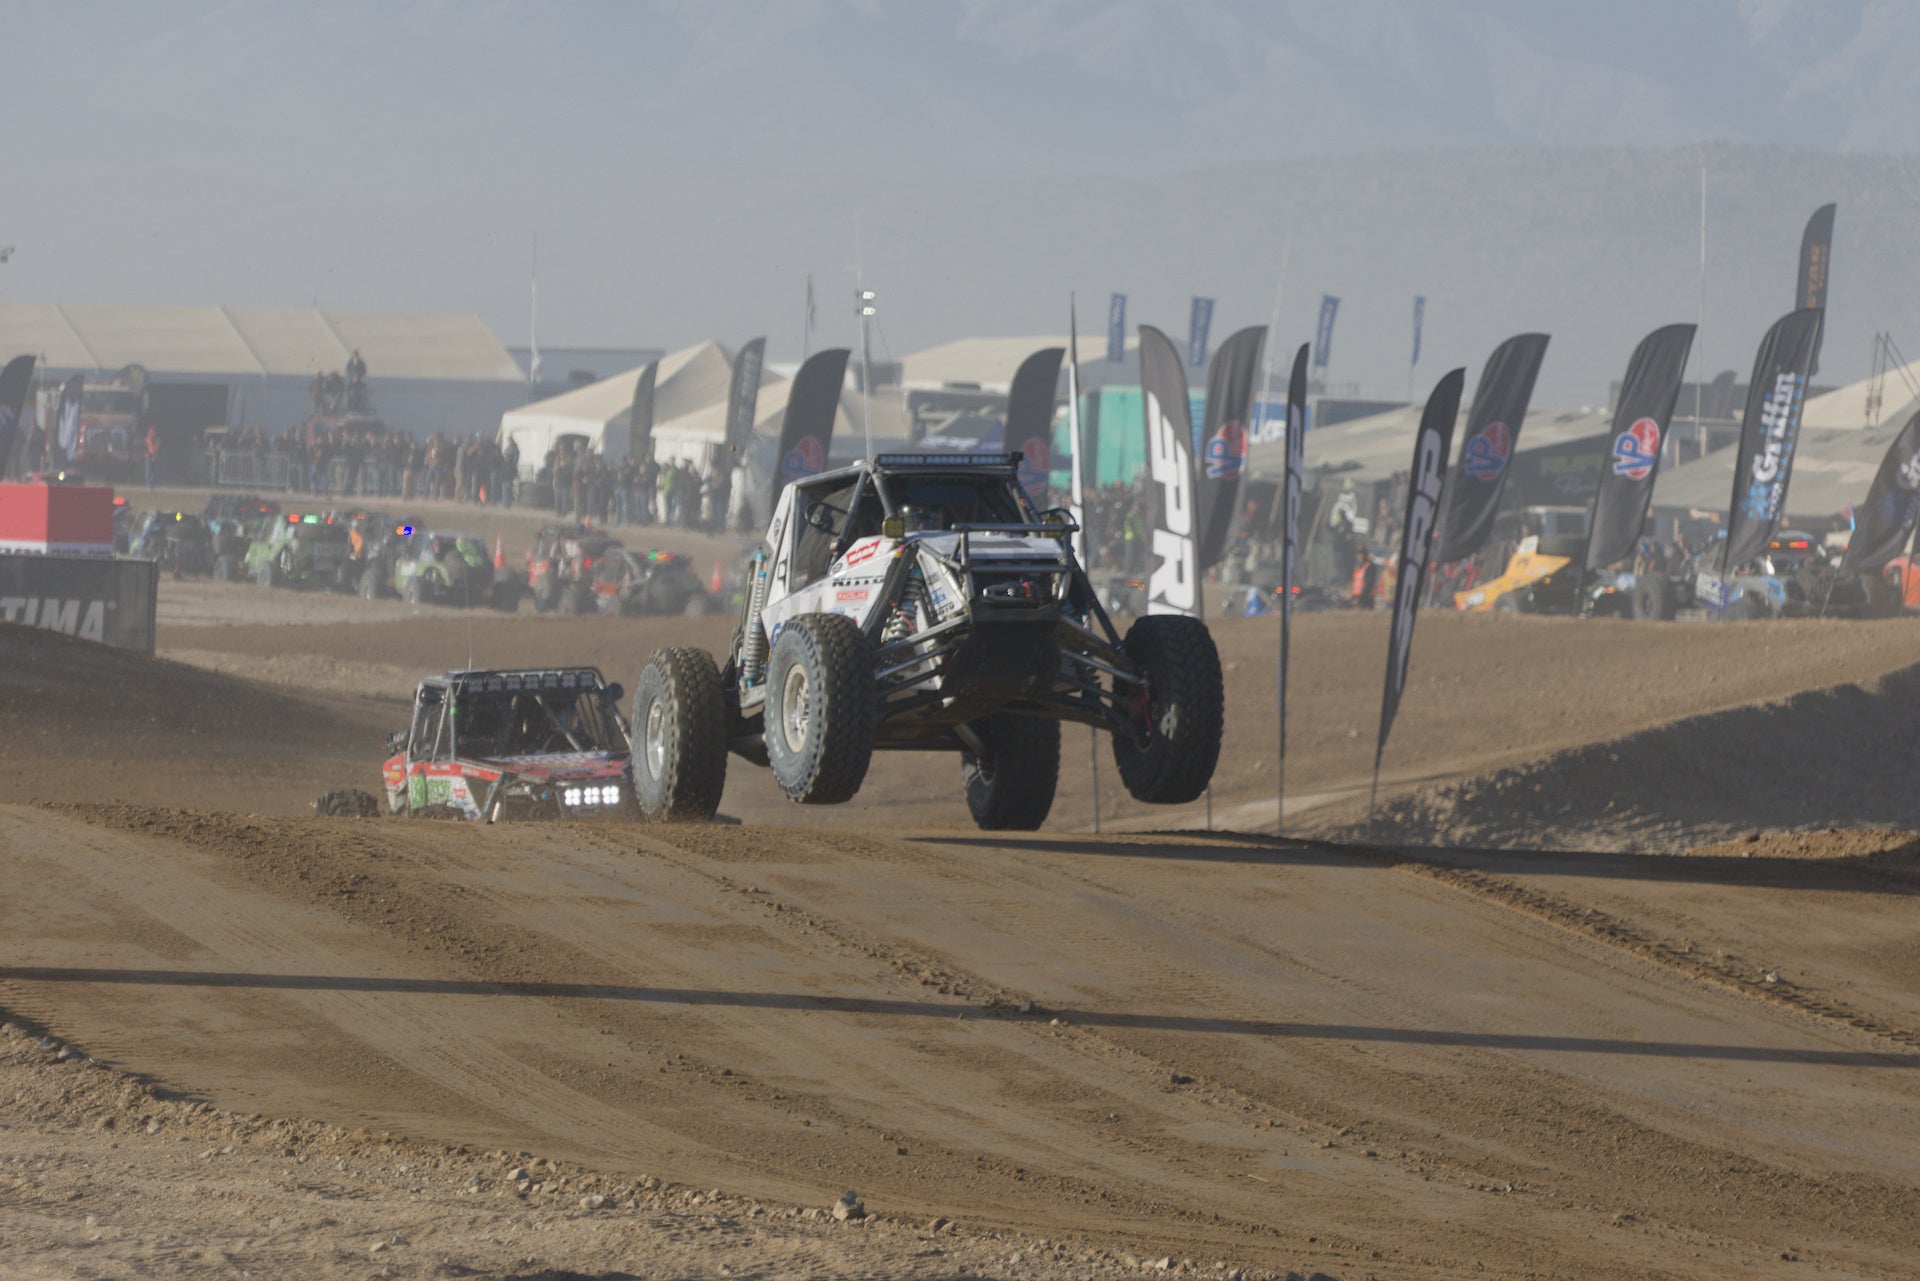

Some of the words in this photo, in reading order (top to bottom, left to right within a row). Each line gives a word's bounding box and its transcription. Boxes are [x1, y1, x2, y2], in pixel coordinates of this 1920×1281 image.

[1752, 371, 1796, 482] Griffin
[1205, 438, 1244, 479] VP
[1464, 435, 1504, 476] VP
[1612, 432, 1656, 476] VP
[1147, 391, 1195, 616] PR
